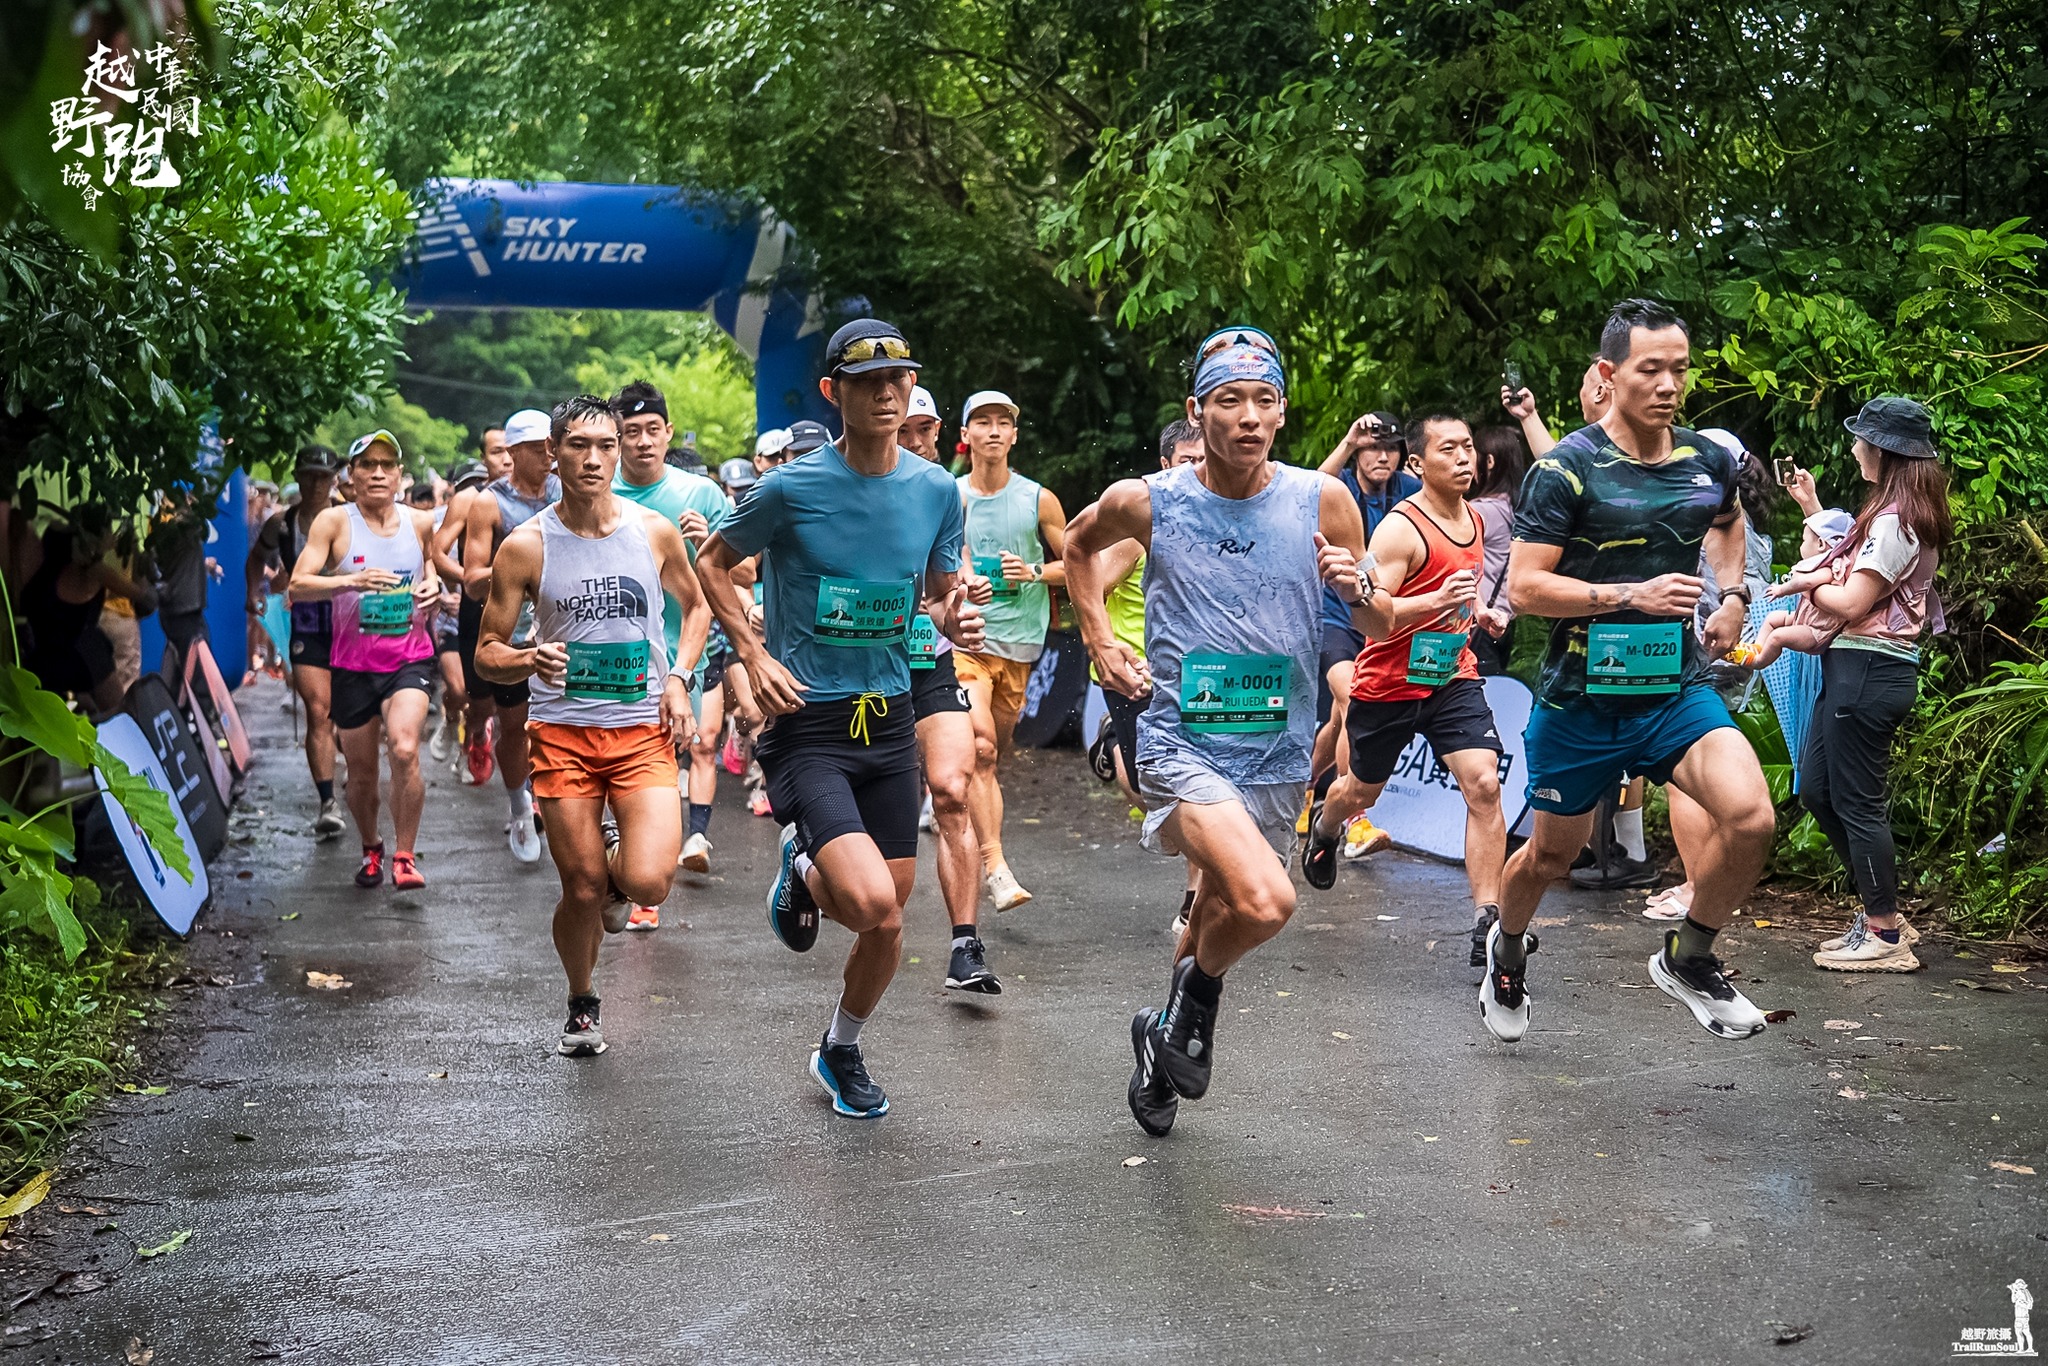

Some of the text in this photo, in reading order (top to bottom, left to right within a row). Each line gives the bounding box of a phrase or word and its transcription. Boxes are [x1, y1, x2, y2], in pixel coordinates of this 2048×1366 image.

[502, 216, 578, 238] SKY
[502, 241, 648, 264] HUNTER
[581, 576, 618, 594] THE
[555, 591, 619, 613] NORTH
[855, 597, 905, 612] M-0003
[575, 606, 618, 623] FACE
[1626, 642, 1677, 657] M-0220
[599, 656, 644, 670] M-0002
[1223, 675, 1283, 690] M-0001
[1225, 697, 1241, 707] RUI
[1242, 696, 1267, 707] UEDA
